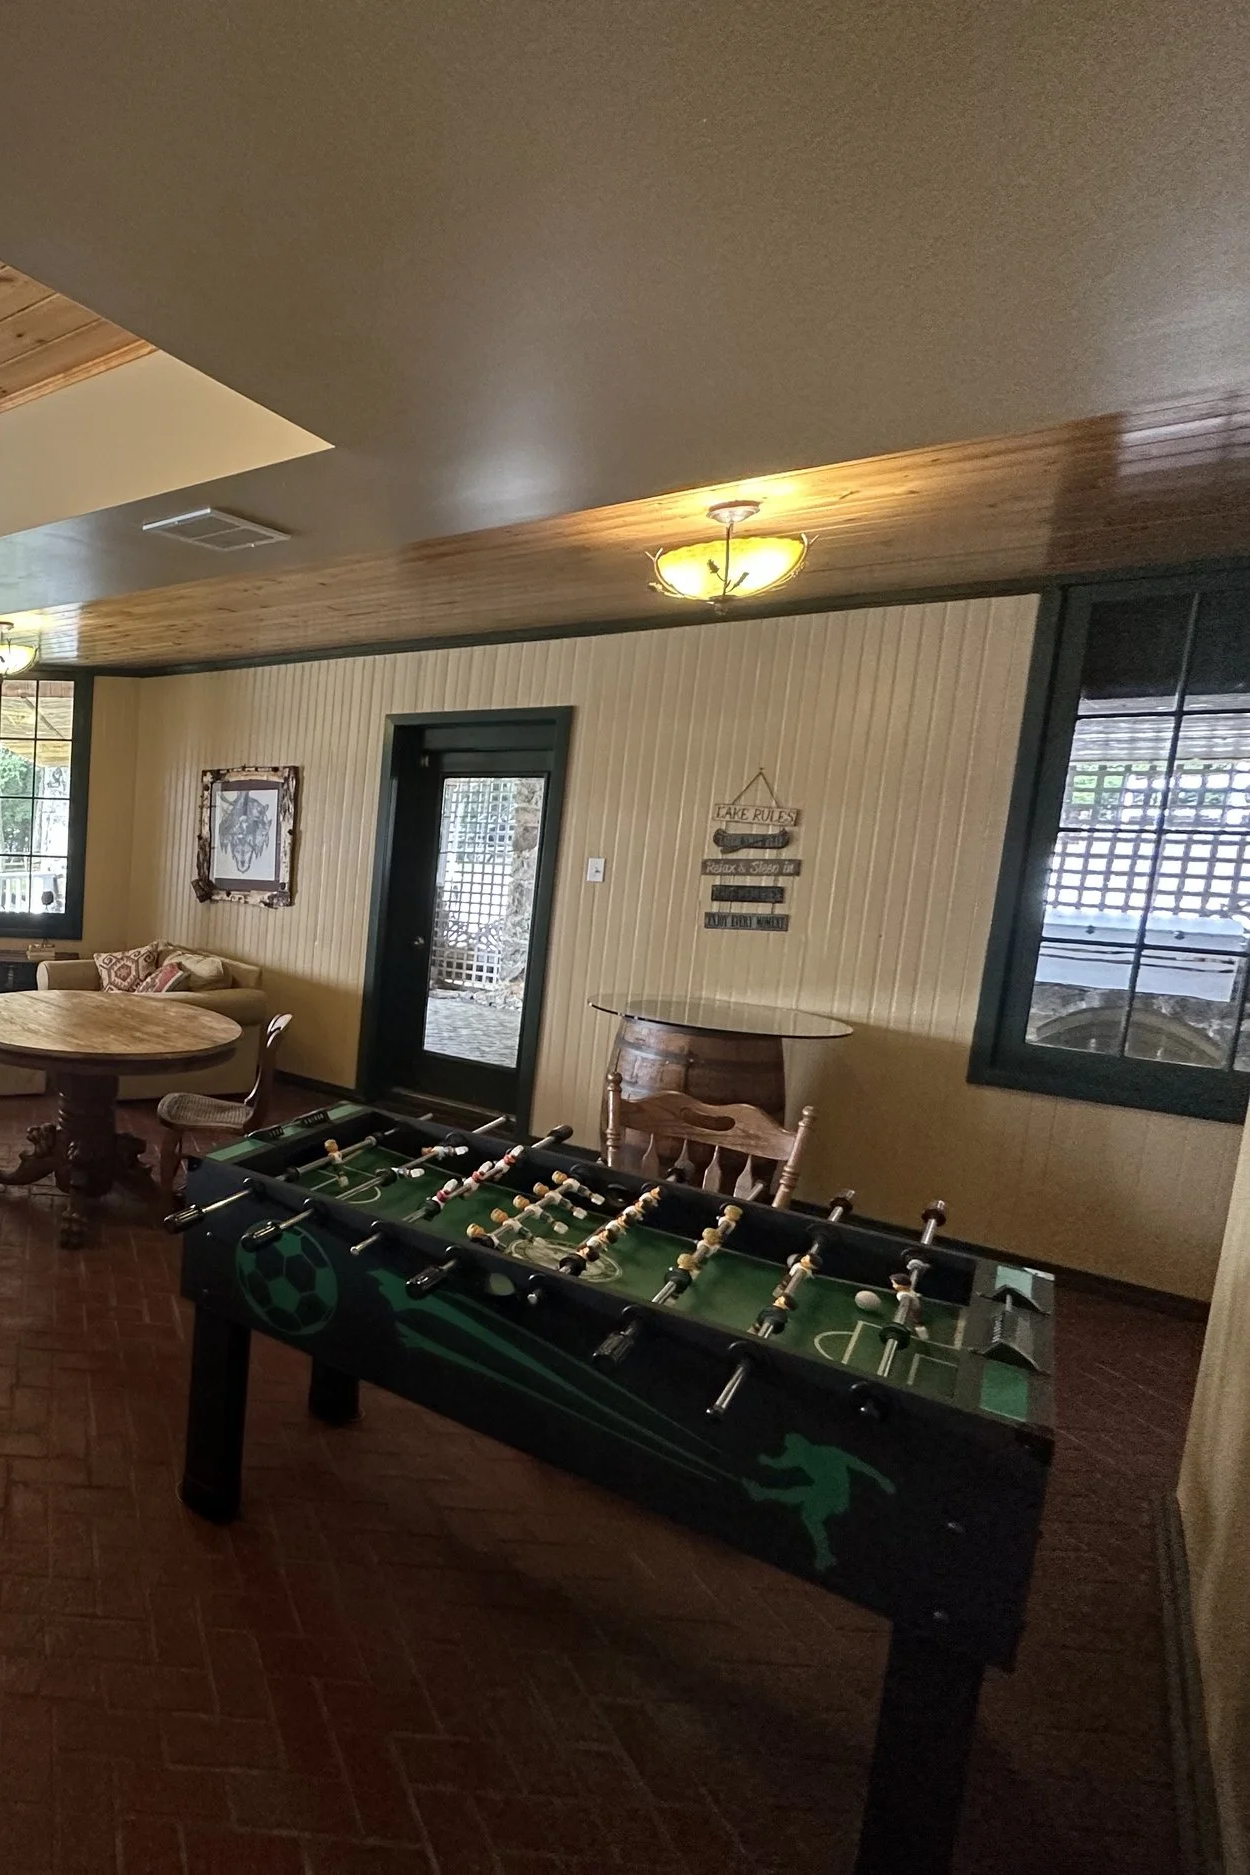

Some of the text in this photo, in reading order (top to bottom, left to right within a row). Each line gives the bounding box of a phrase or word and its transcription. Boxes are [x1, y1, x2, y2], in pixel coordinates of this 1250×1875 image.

[716, 805, 795, 824] LAKE RULES
[706, 861, 736, 874] Relax
[738, 863, 746, 873] &
